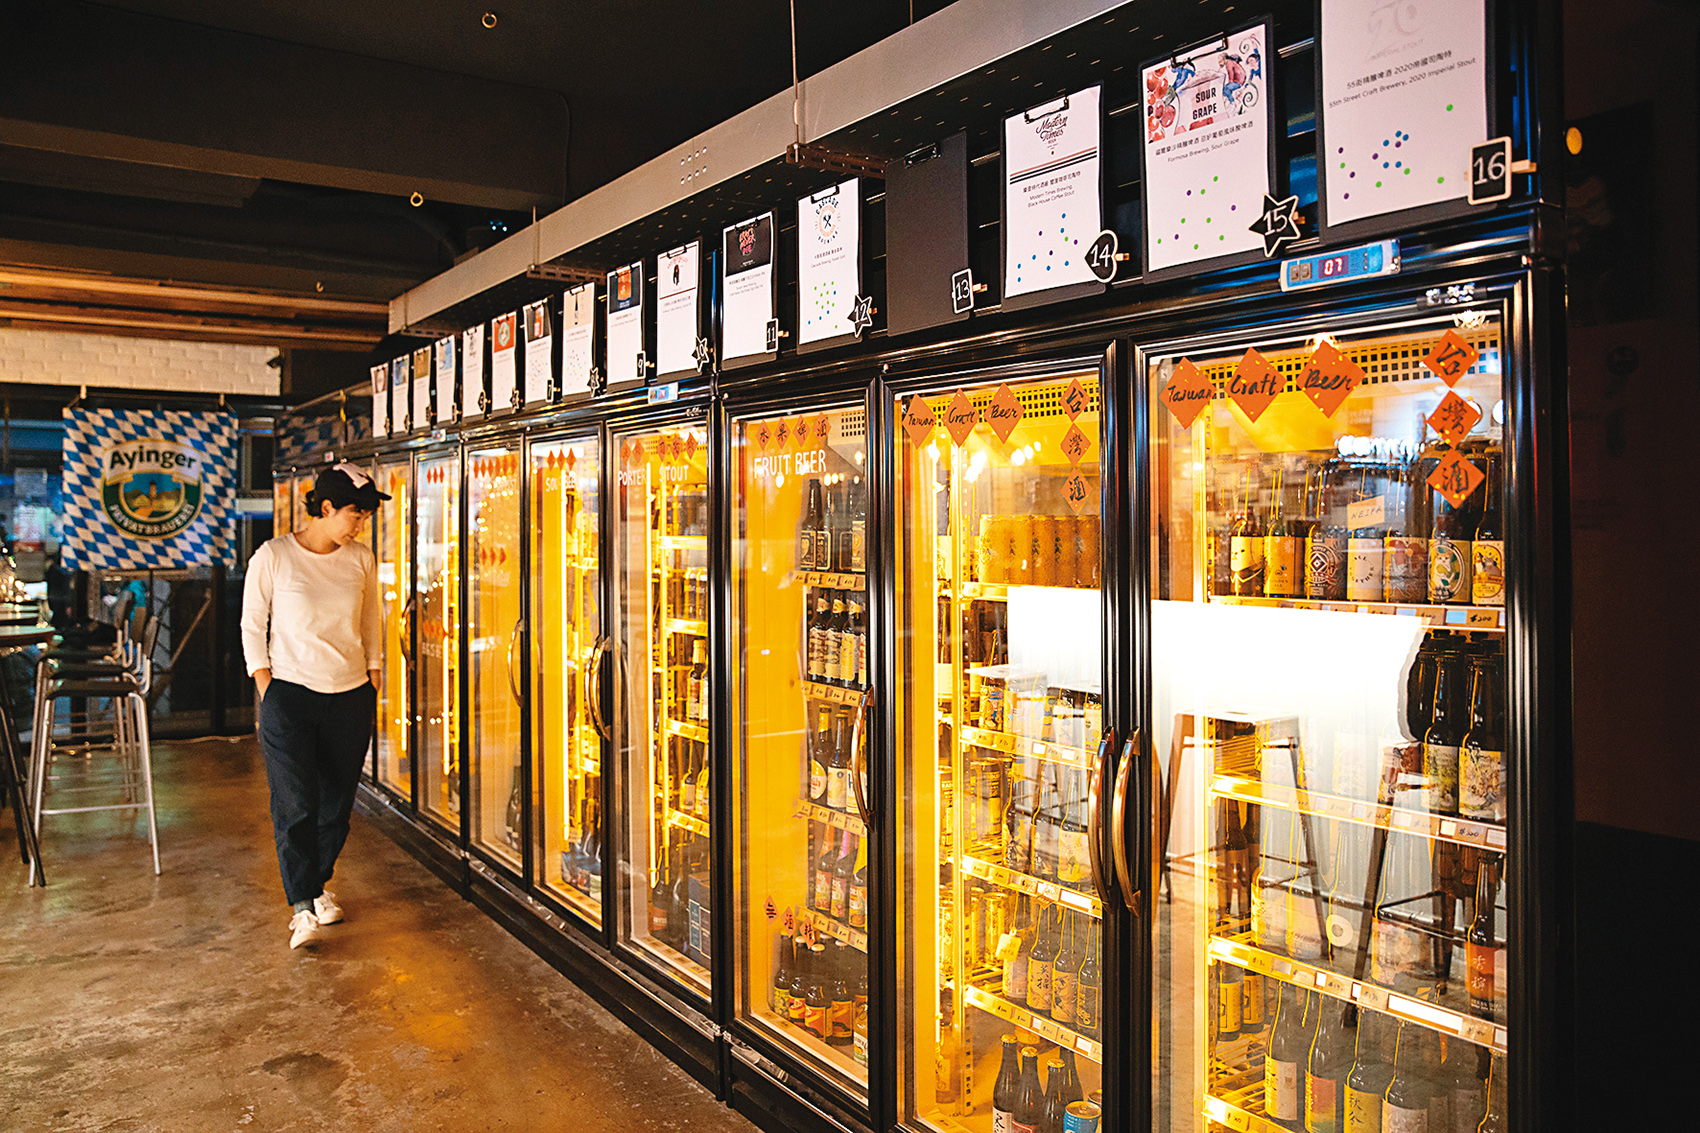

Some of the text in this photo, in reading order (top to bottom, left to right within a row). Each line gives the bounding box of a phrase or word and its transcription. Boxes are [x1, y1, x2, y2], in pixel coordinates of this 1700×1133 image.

[1329, 97, 1342, 108] 55th
[1343, 93, 1361, 103] Street
[1362, 88, 1378, 98] Craft
[1409, 72, 1427, 83] 2020
[1428, 65, 1455, 77] Imperial
[1456, 57, 1476, 68] Stout
[1195, 88, 1217, 104] SOUR
[1192, 104, 1217, 120] GRAPE
[1036, 114, 1068, 134] Modern
[1040, 129, 1064, 141] Times
[1224, 138, 1239, 147] Grape
[1473, 152, 1505, 185] 16
[815, 197, 839, 215] CASCADE
[1263, 205, 1288, 235] 15
[1091, 244, 1111, 268] 14
[1324, 257, 1343, 275] 07
[955, 279, 970, 302] 13
[854, 303, 869, 324] 12
[766, 327, 776, 343] 11
[696, 344, 706, 360] 10
[638, 359, 644, 374] 9
[1167, 369, 1352, 402] Taiwan Craft Beer
[949, 407, 976, 424] Craft
[991, 404, 1020, 419] Beer
[109, 445, 197, 470] Ayinger
[754, 449, 827, 479] FRUIT BEER
[618, 464, 689, 486] PORTER STOUT
[109, 503, 196, 534] PRIVATBRAUEREI
[1351, 506, 1383, 520] NEIPA
